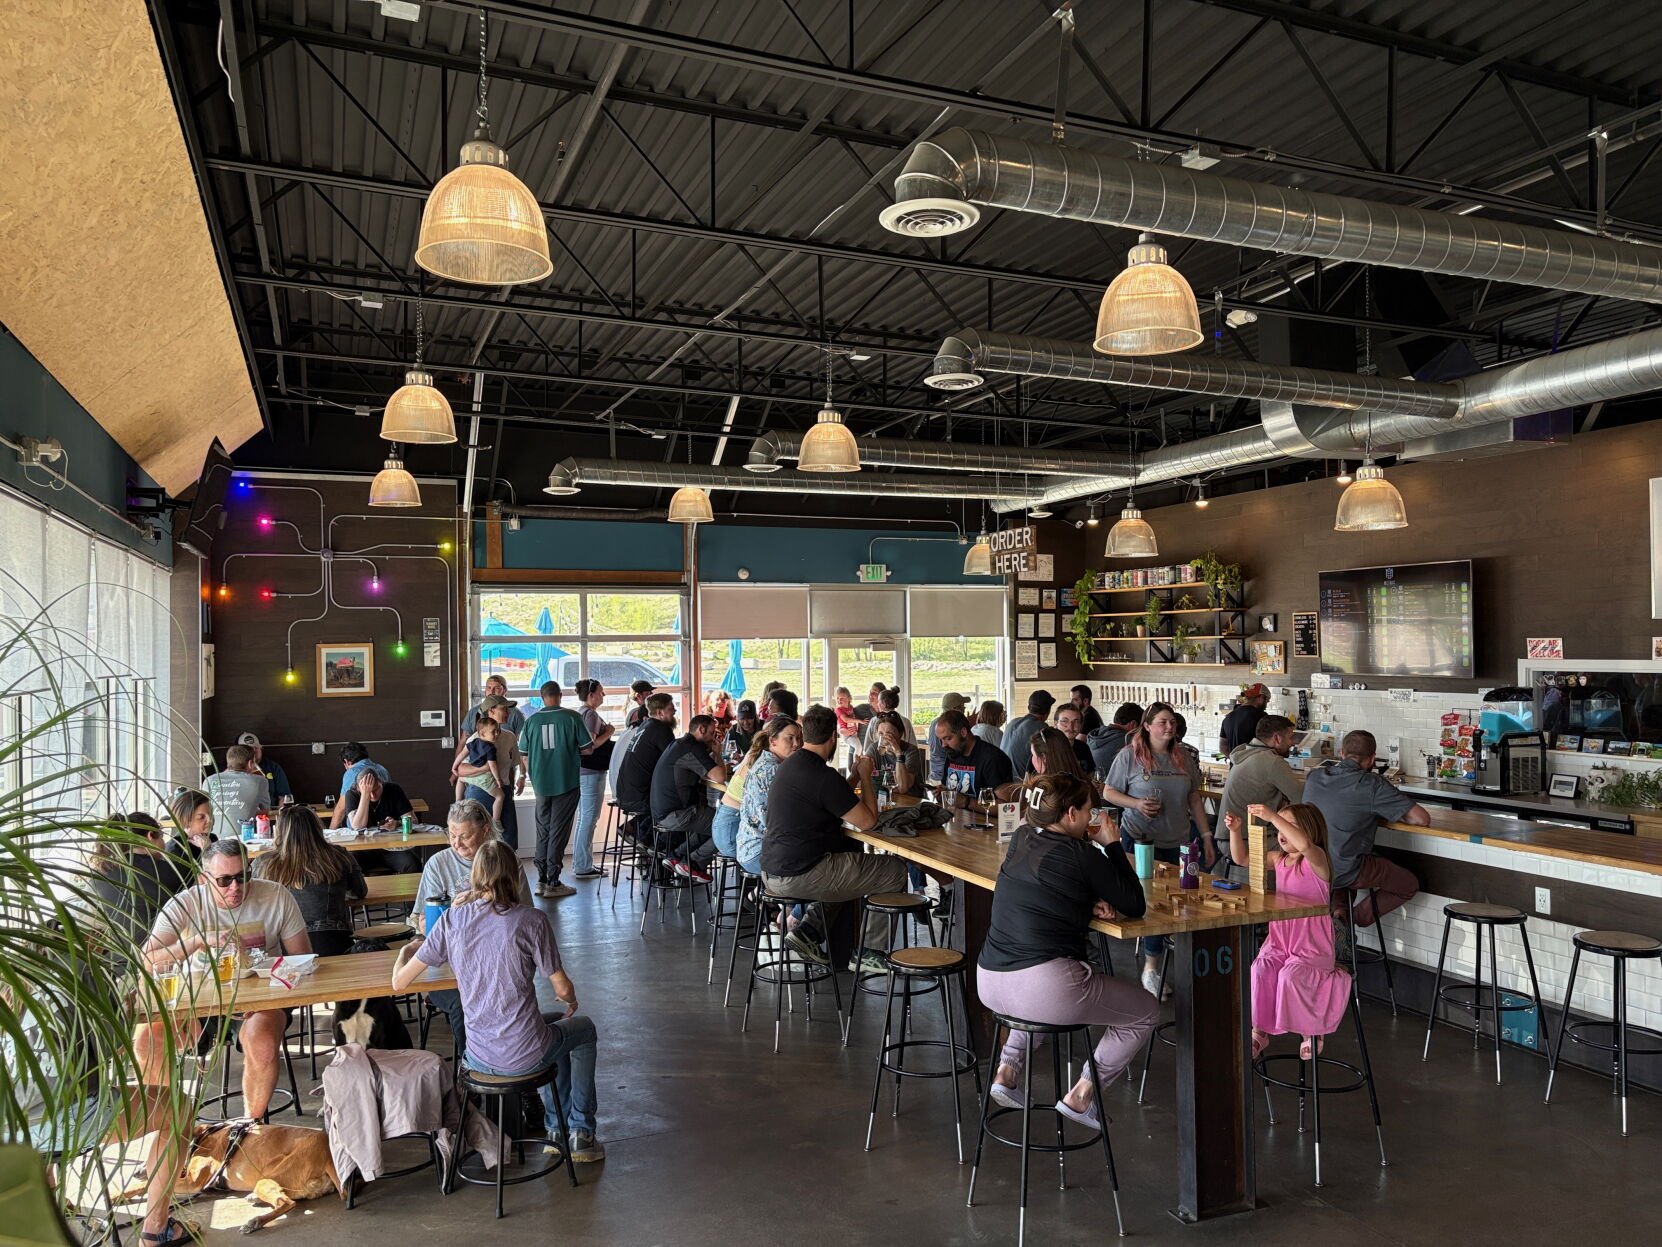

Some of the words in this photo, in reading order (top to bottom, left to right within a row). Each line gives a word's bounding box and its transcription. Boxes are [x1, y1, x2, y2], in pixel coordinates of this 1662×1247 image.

[991, 527, 1032, 552] ORDER
[866, 565, 883, 579] EXIT
[996, 552, 1029, 575] HERE
[541, 723, 556, 750] 11
